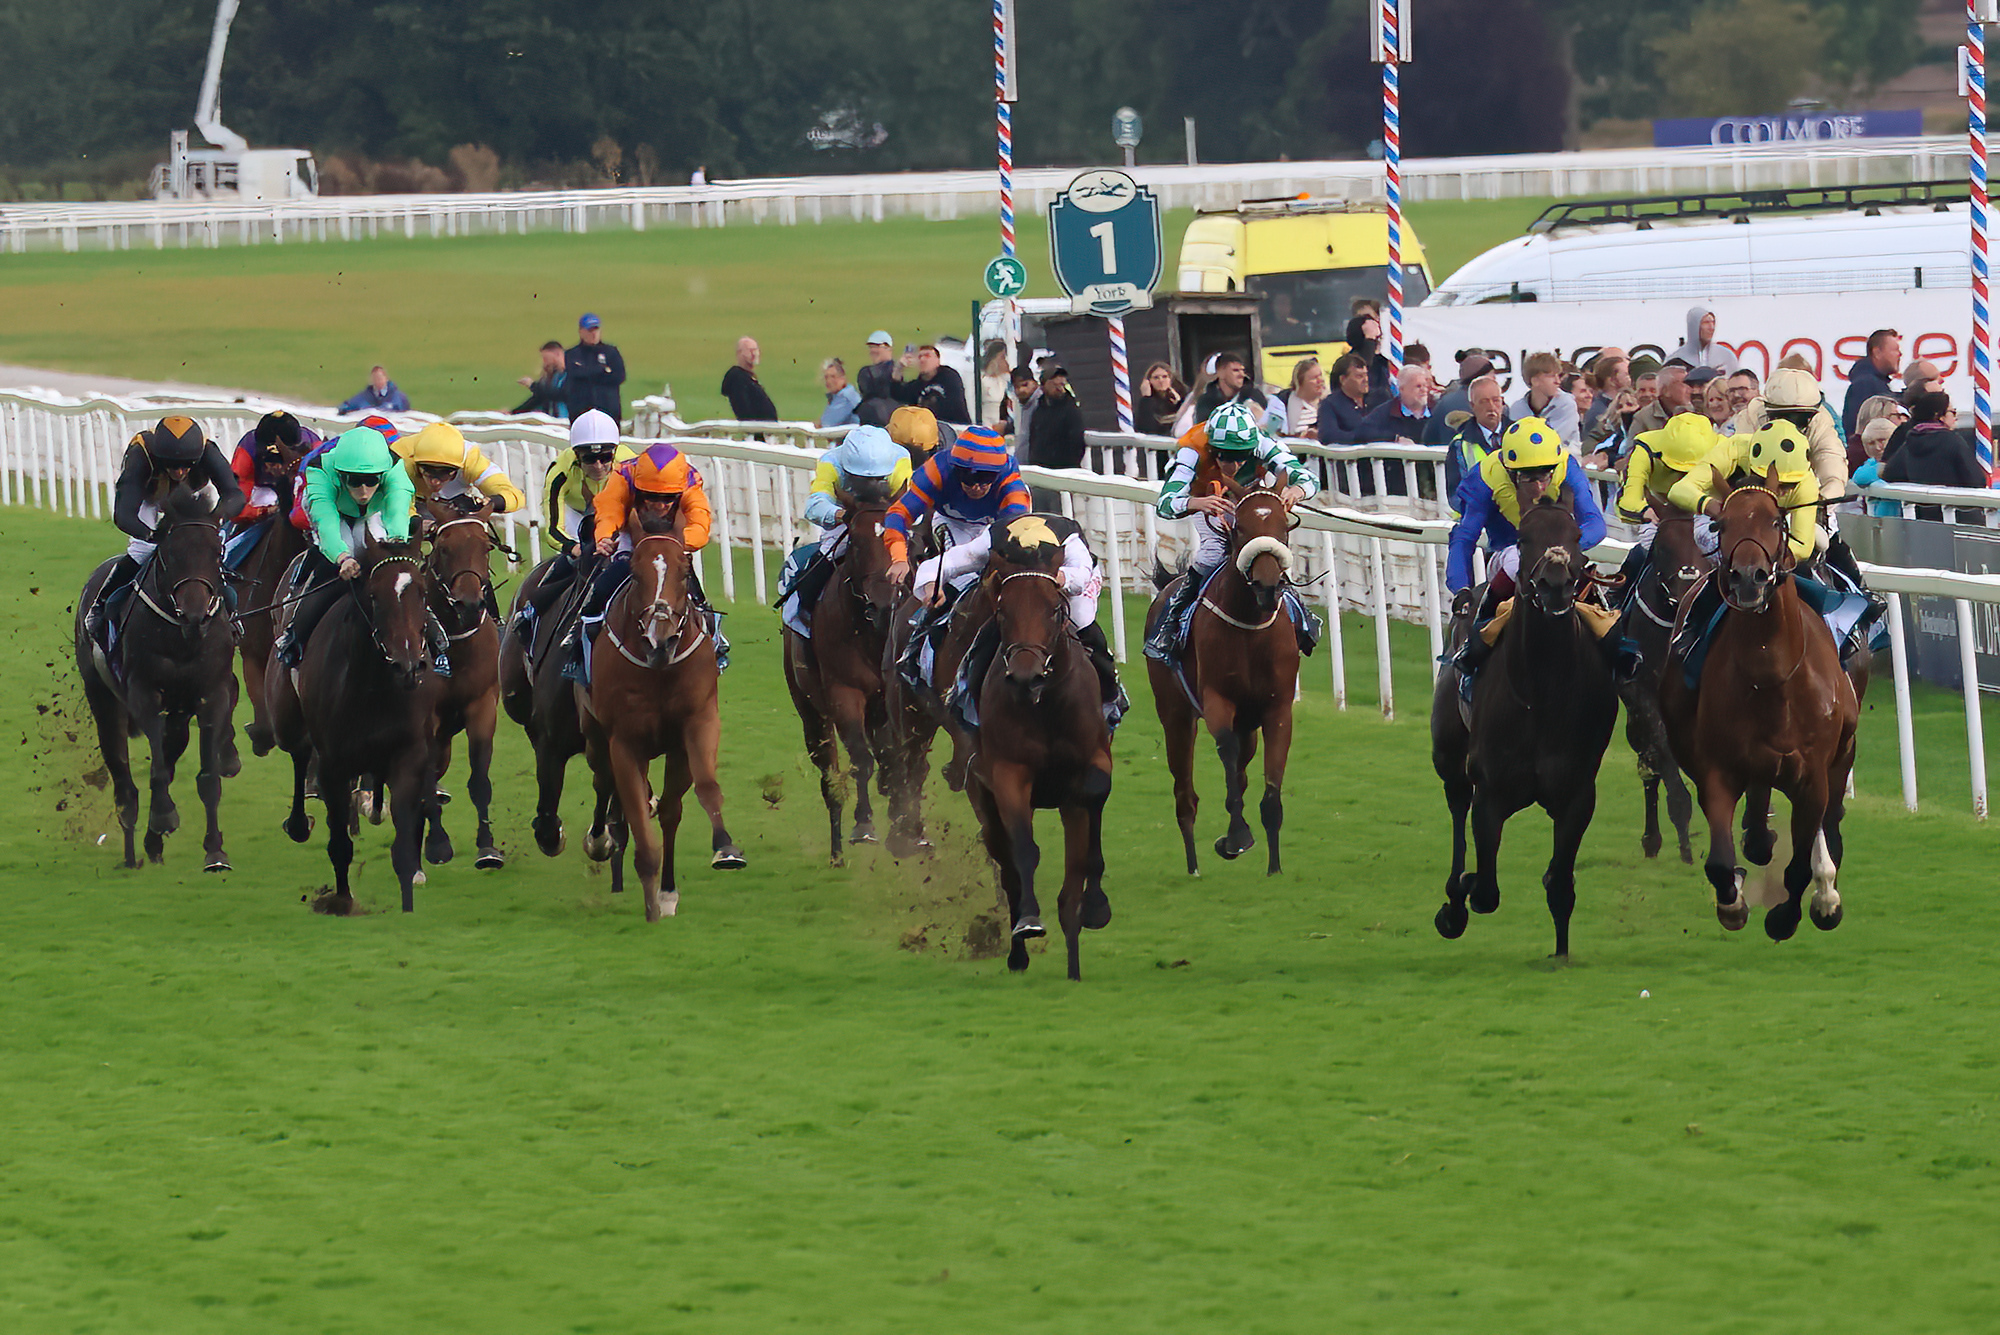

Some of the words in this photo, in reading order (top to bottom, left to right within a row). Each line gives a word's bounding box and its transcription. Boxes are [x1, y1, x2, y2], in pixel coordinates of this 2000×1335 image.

[1710, 116, 1865, 147] COOLMORE
[1089, 221, 1117, 275] 1
[1094, 286, 1126, 300] York
